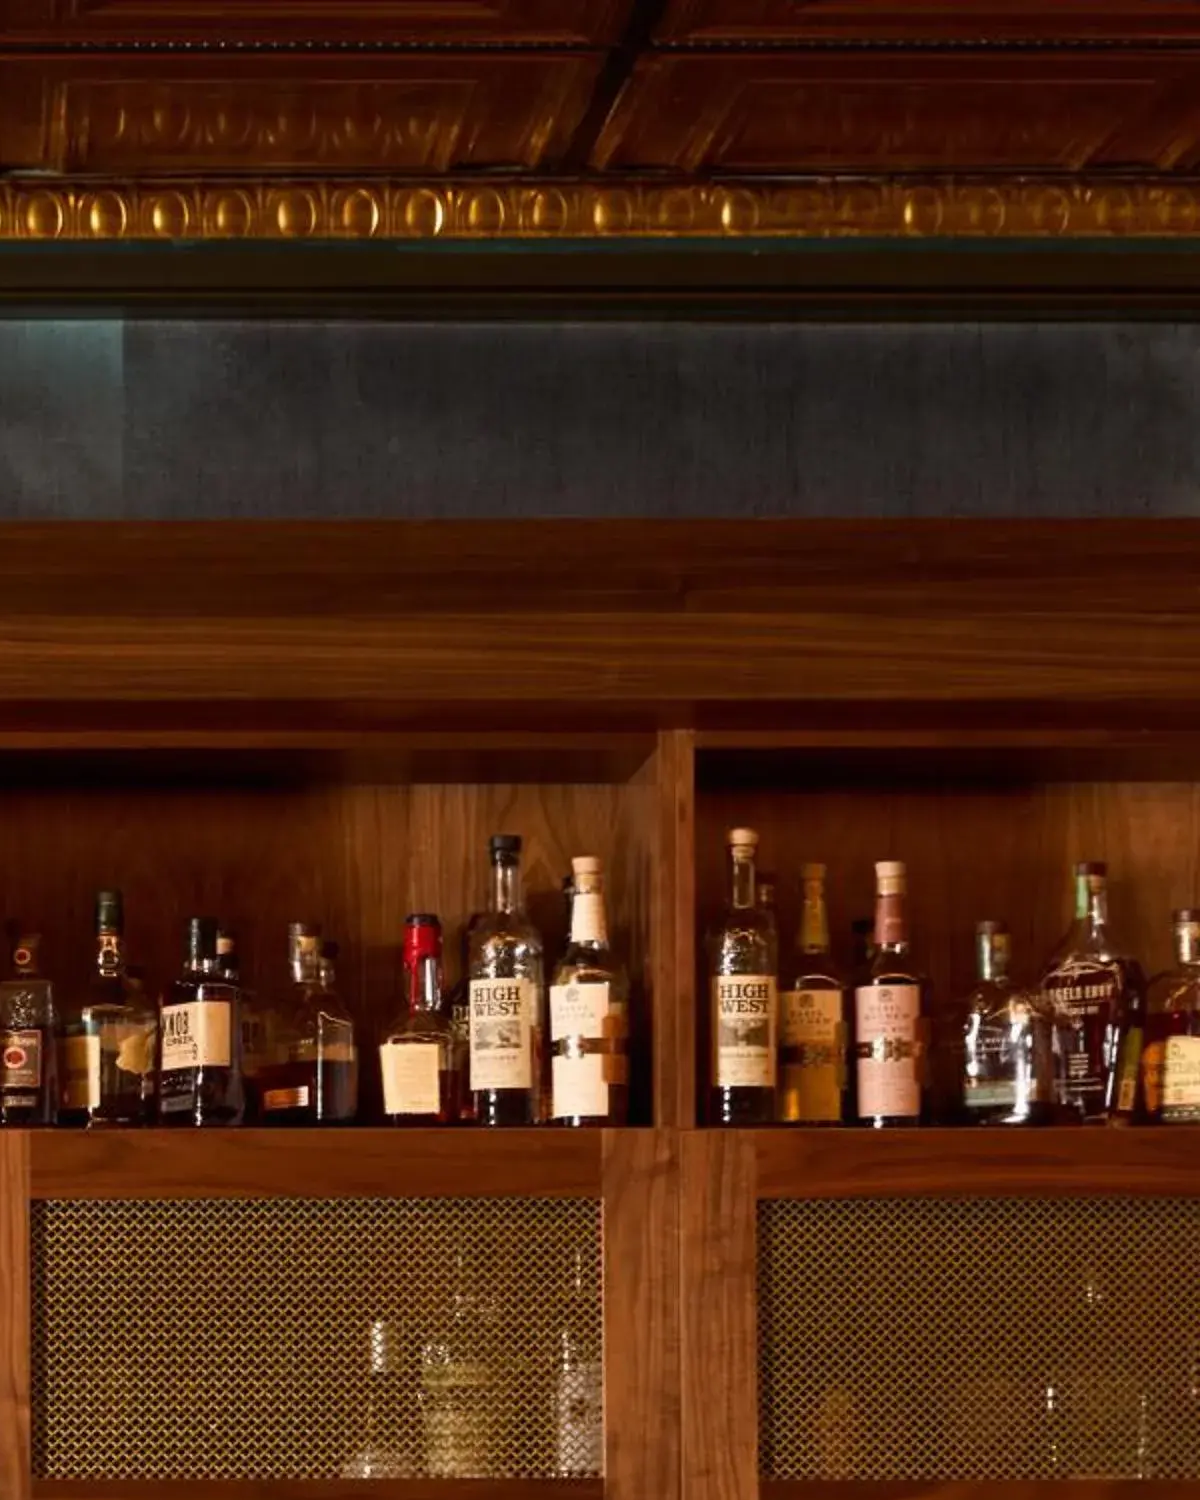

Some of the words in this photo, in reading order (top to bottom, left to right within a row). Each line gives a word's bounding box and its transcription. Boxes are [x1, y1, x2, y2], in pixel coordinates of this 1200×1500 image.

[473, 986, 521, 1002] HIGH
[719, 983, 769, 999] HIGH
[474, 1001, 521, 1017] WEST
[719, 1000, 770, 1013] WEST
